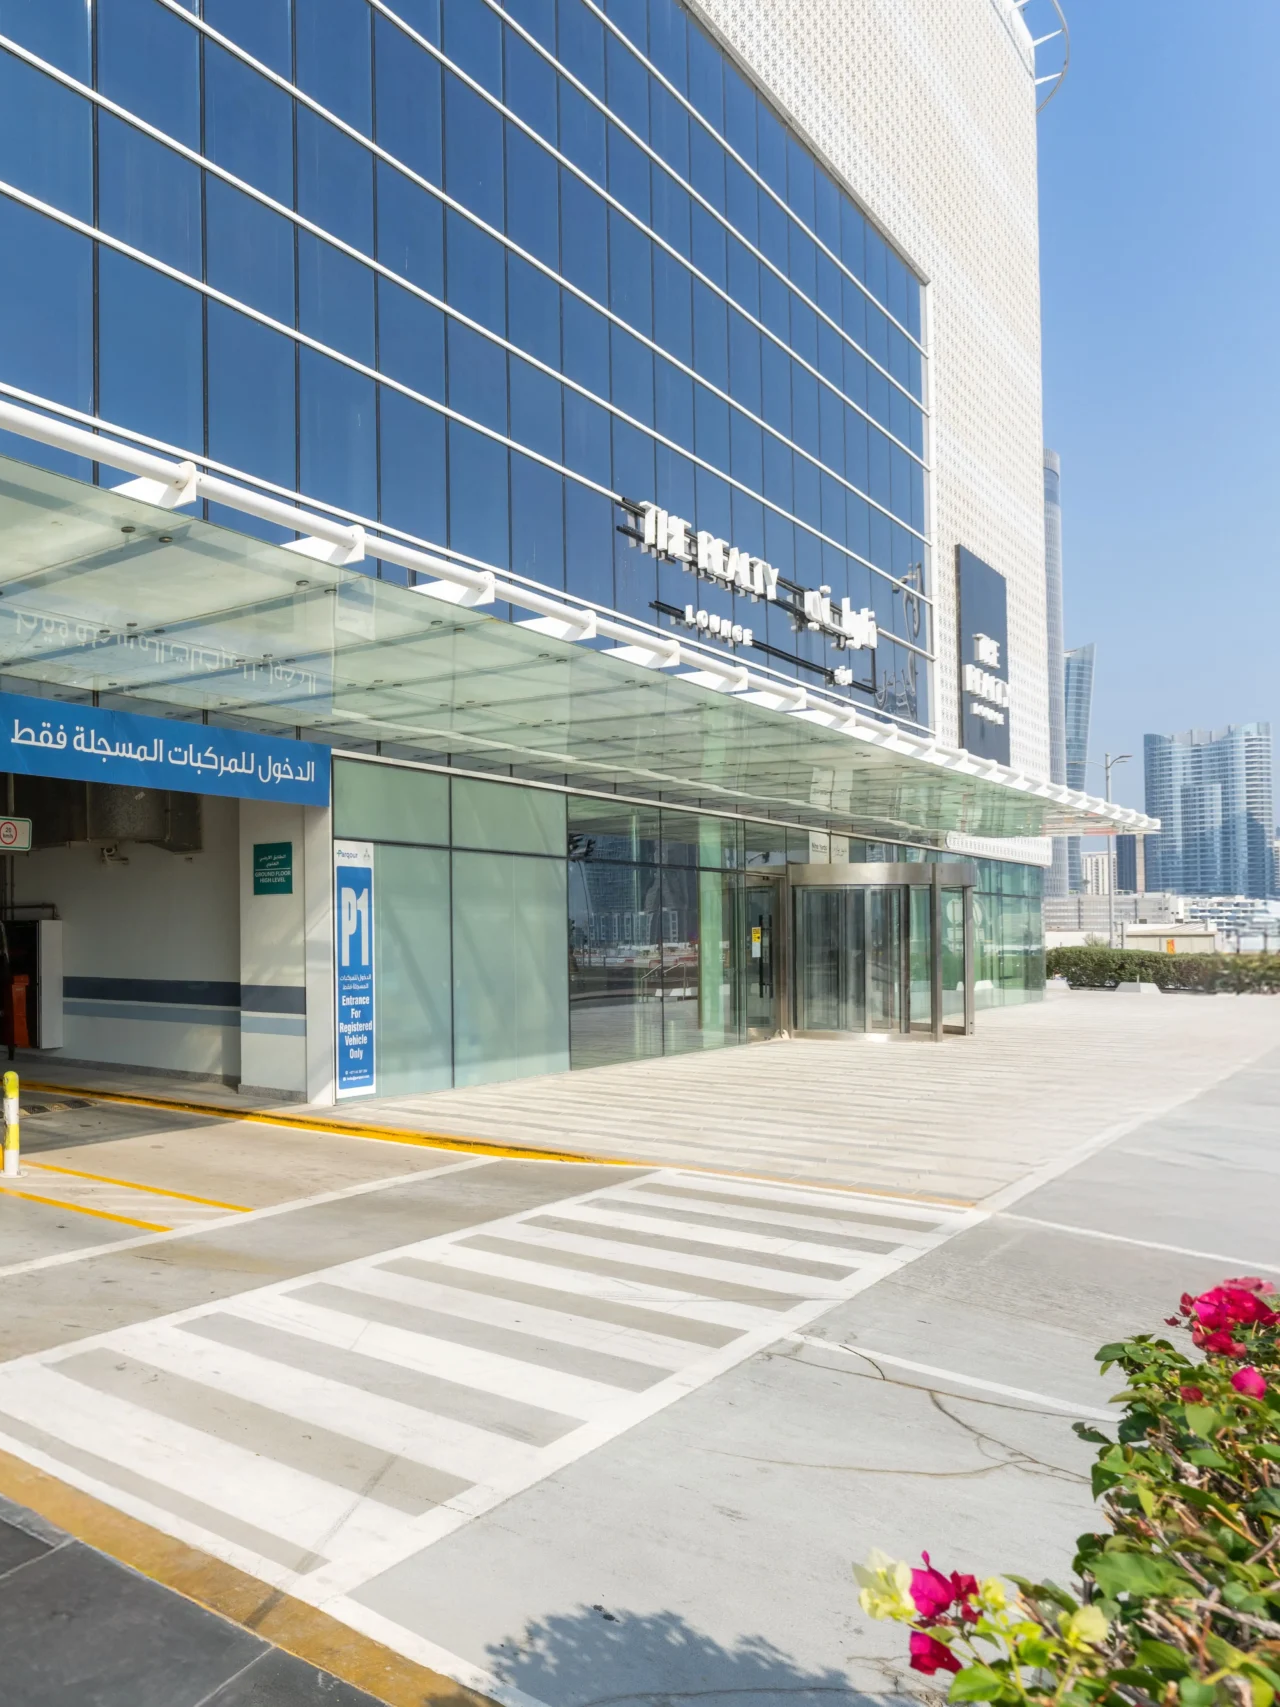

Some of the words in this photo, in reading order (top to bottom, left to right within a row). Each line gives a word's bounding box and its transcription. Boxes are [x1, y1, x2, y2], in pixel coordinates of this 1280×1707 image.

[638, 500, 693, 562] THE
[9, 718, 68, 750] فقط
[72, 725, 165, 763] المسجلة
[167, 743, 256, 777] للمركبات
[257, 754, 316, 784] الدخول
[341, 887, 369, 967] P1
[341, 995, 370, 1006] Entrance
[350, 1008, 361, 1019] For
[339, 1020, 373, 1034] Registered
[344, 1034, 368, 1046] Vehicle
[349, 1048, 363, 1060] Only
